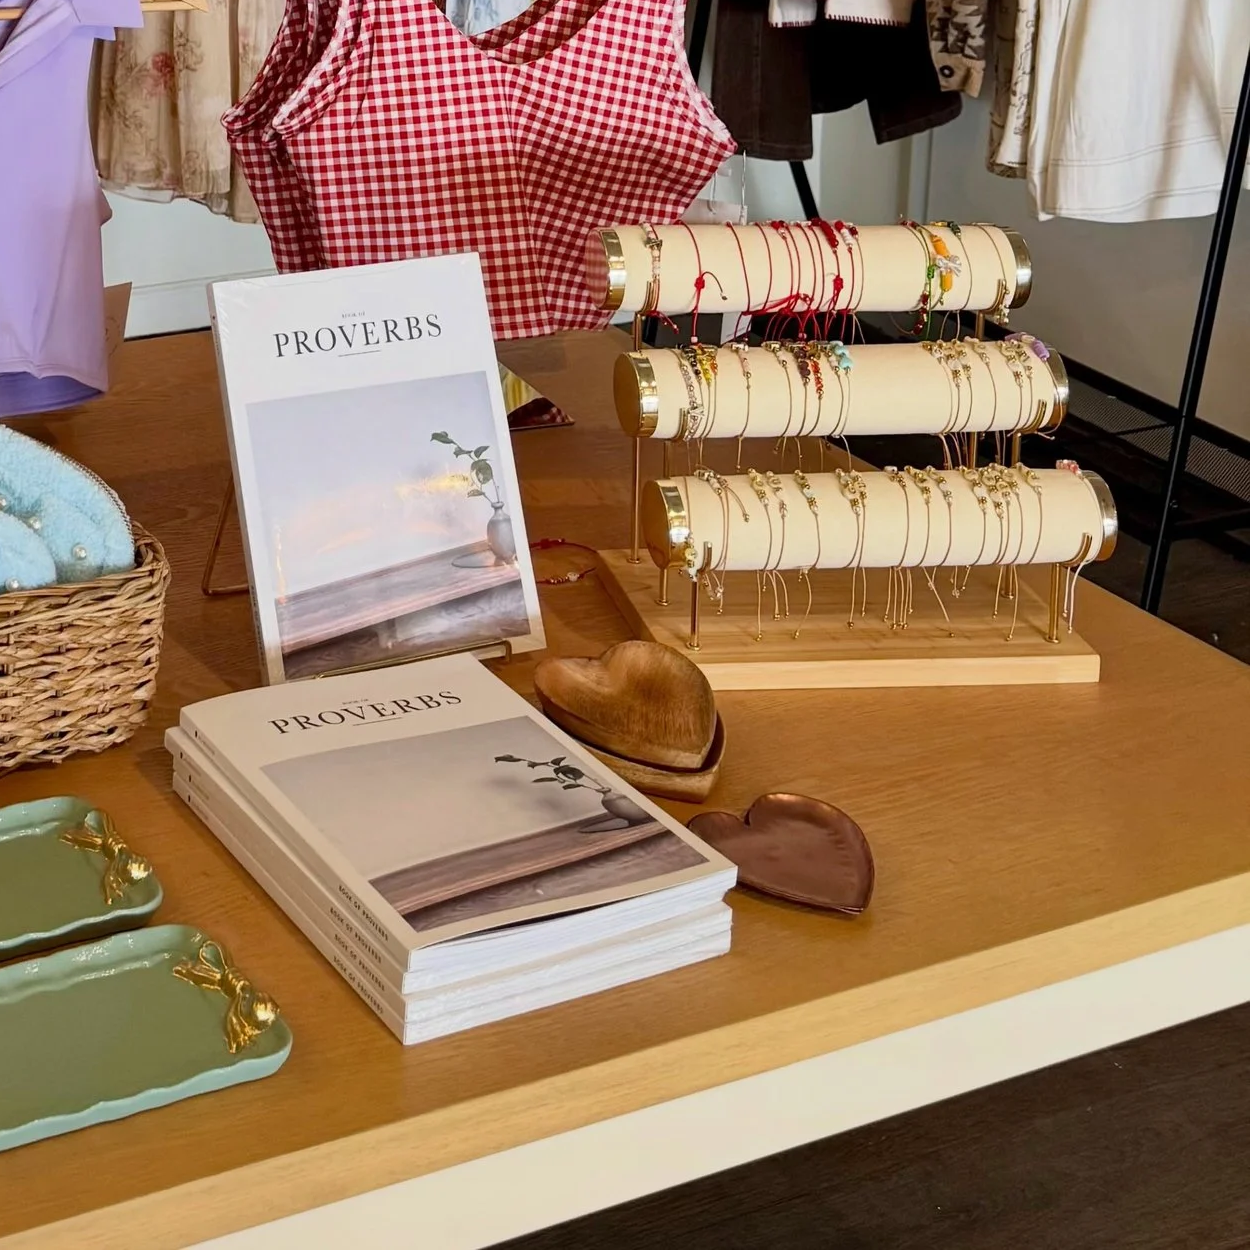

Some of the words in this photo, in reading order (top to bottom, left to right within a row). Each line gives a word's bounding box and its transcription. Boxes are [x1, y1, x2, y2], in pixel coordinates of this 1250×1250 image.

[273, 313, 442, 358] PROVERBS
[268, 690, 462, 735] PROVERBS
[338, 885, 352, 902] BOOK
[362, 909, 388, 941] PROVERBS
[354, 931, 382, 964] PROVERBS
